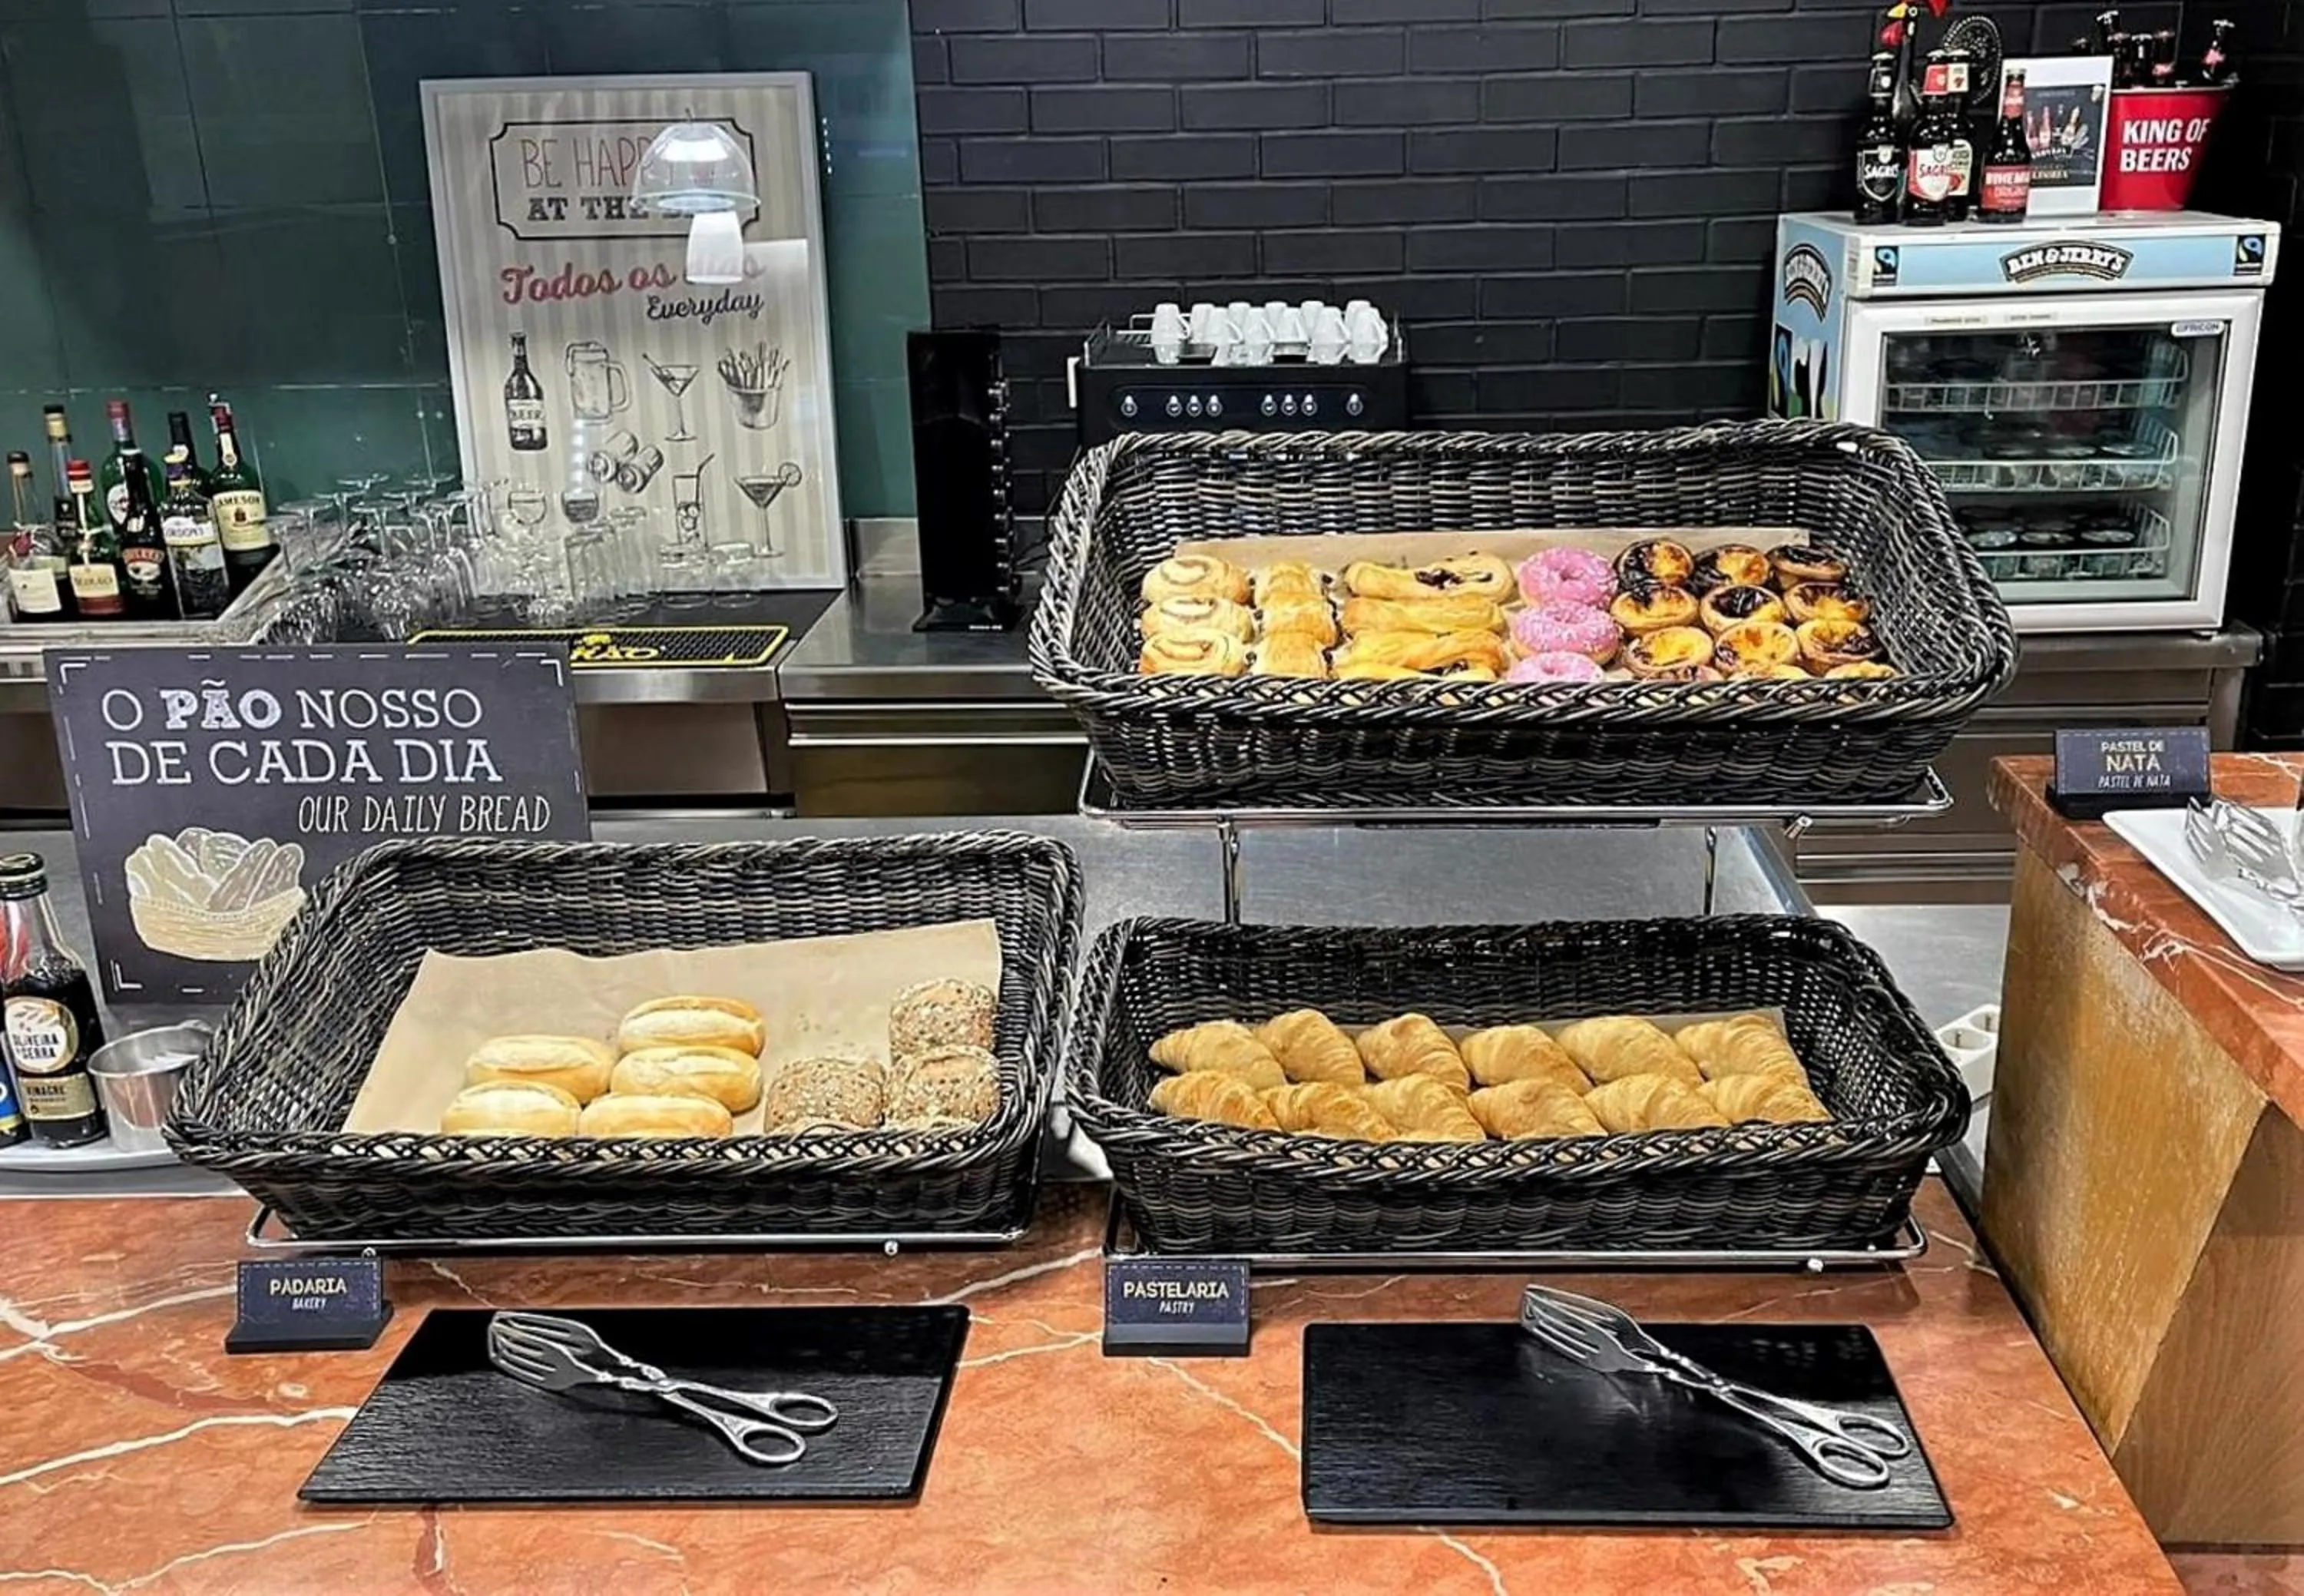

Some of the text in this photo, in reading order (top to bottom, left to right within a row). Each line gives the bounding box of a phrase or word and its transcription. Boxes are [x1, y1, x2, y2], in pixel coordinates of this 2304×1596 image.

[2123, 118, 2211, 144] KING OF
[521, 139, 562, 188] BE
[2120, 146, 2192, 172] BEERS
[527, 197, 568, 221] AT
[580, 196, 649, 220] THE
[2007, 247, 2126, 274] BEN & JERRY'S
[501, 262, 622, 304] Todos
[628, 263, 677, 290] os
[647, 288, 765, 326] Everyday
[102, 679, 482, 730] O PÃO NOSSO
[2100, 740, 2164, 753] PASTEL DE
[105, 738, 503, 785] DE CADA DIA
[2107, 753, 2161, 772] NATA
[299, 794, 551, 833] OUR DAILY BREAD
[270, 1277, 347, 1296] PADARIA
[1123, 1280, 1230, 1299] PASTELARIA
[1159, 1300, 1195, 1315] PASTRY
